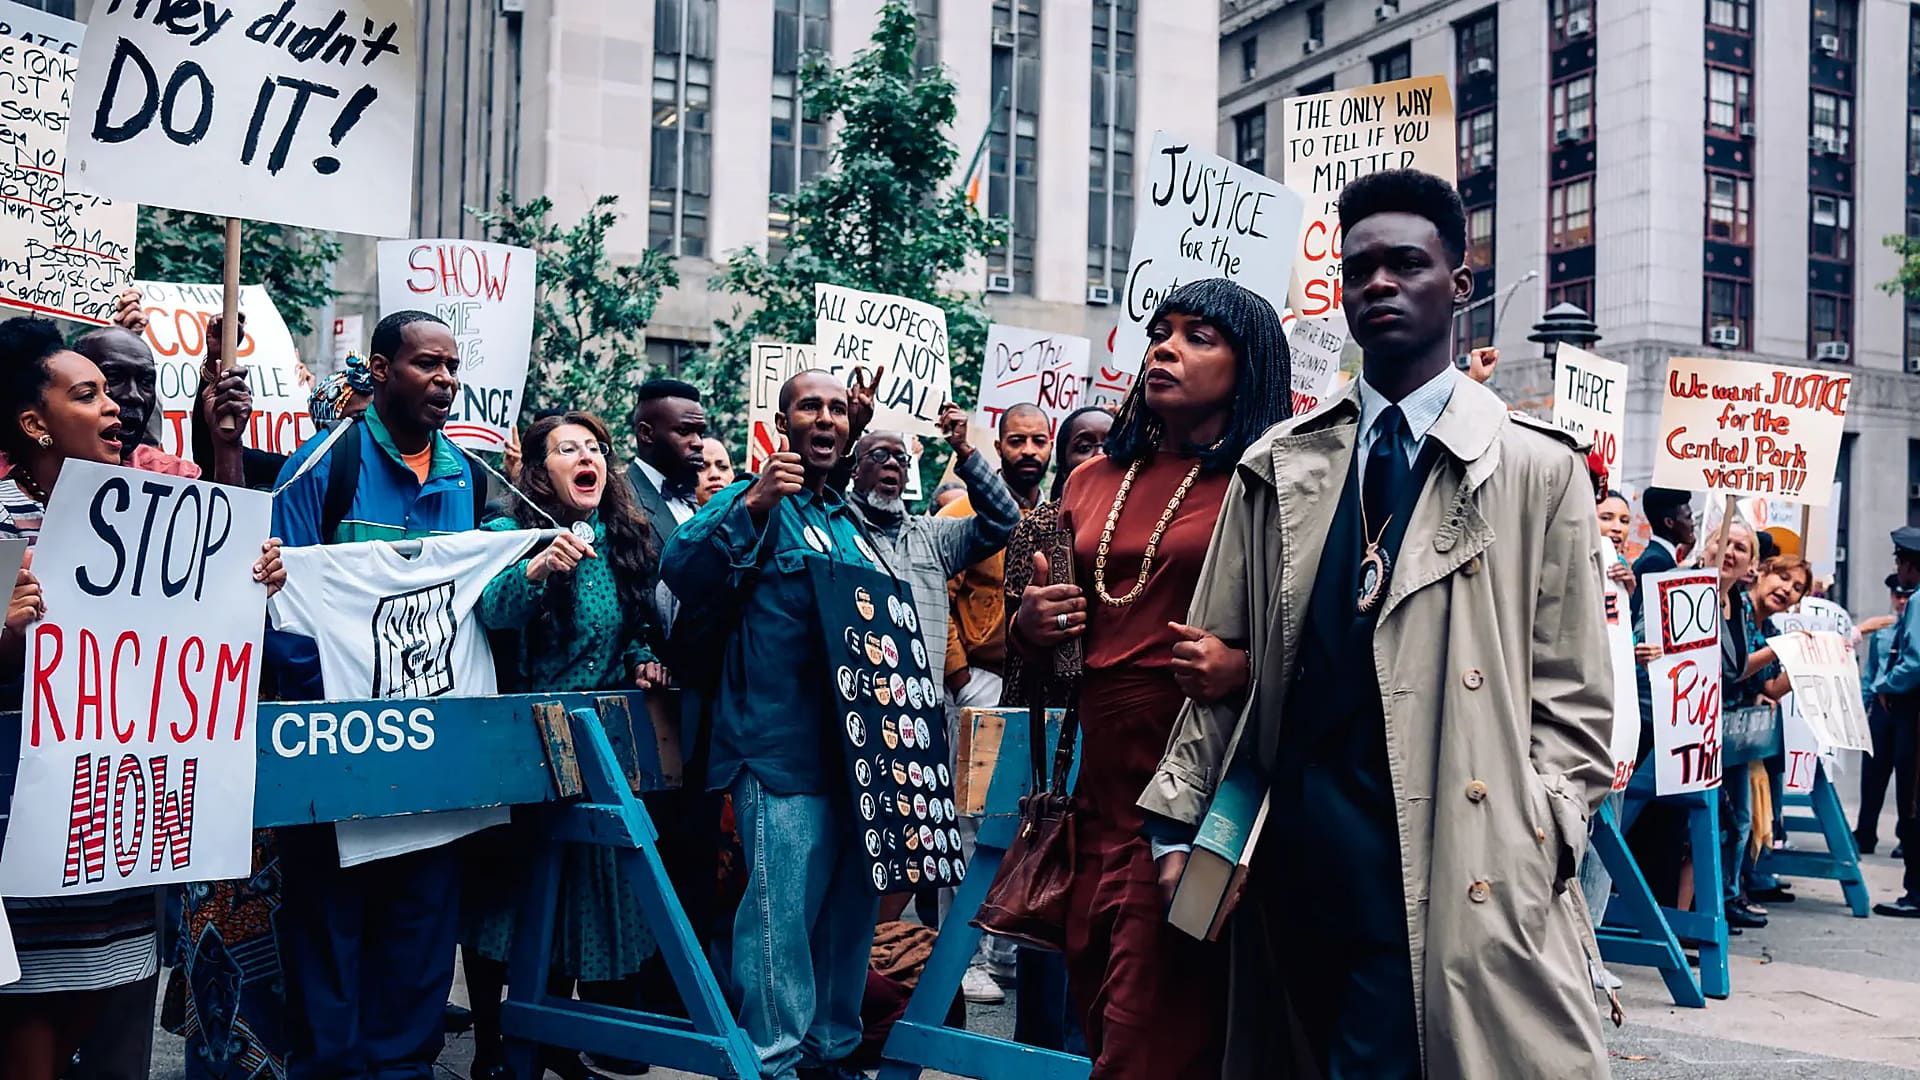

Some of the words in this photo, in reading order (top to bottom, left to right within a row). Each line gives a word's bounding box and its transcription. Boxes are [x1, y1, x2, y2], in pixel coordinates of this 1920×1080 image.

[245, 0, 400, 67] didn't
[91, 36, 214, 146] DO
[240, 75, 378, 176] IT!
[1295, 100, 1334, 132] THE
[1340, 96, 1387, 126] ONLY
[1396, 87, 1433, 117] WAY
[1289, 138, 1315, 163] TO
[1322, 133, 1360, 157] TELL
[1367, 127, 1386, 148] IF
[1394, 121, 1430, 145] YOU
[406, 244, 512, 302] SHOW
[816, 292, 846, 323] ALL
[855, 299, 946, 357] SUSPECTS
[833, 332, 873, 362] ARE
[892, 342, 945, 385] NOT
[1565, 364, 1616, 415] THERE
[1670, 370, 1708, 398] We
[1712, 383, 1764, 402] want
[1765, 372, 1851, 416] JUSTICE
[1717, 403, 1750, 431] for
[1751, 408, 1790, 435] the
[1666, 427, 1750, 464] Central
[1755, 436, 1808, 469] Park
[75, 477, 232, 601] STOP
[1669, 586, 1718, 642] DO
[31, 623, 253, 747] RACISM
[271, 707, 436, 759] CROSS
[62, 752, 198, 888] NOW
